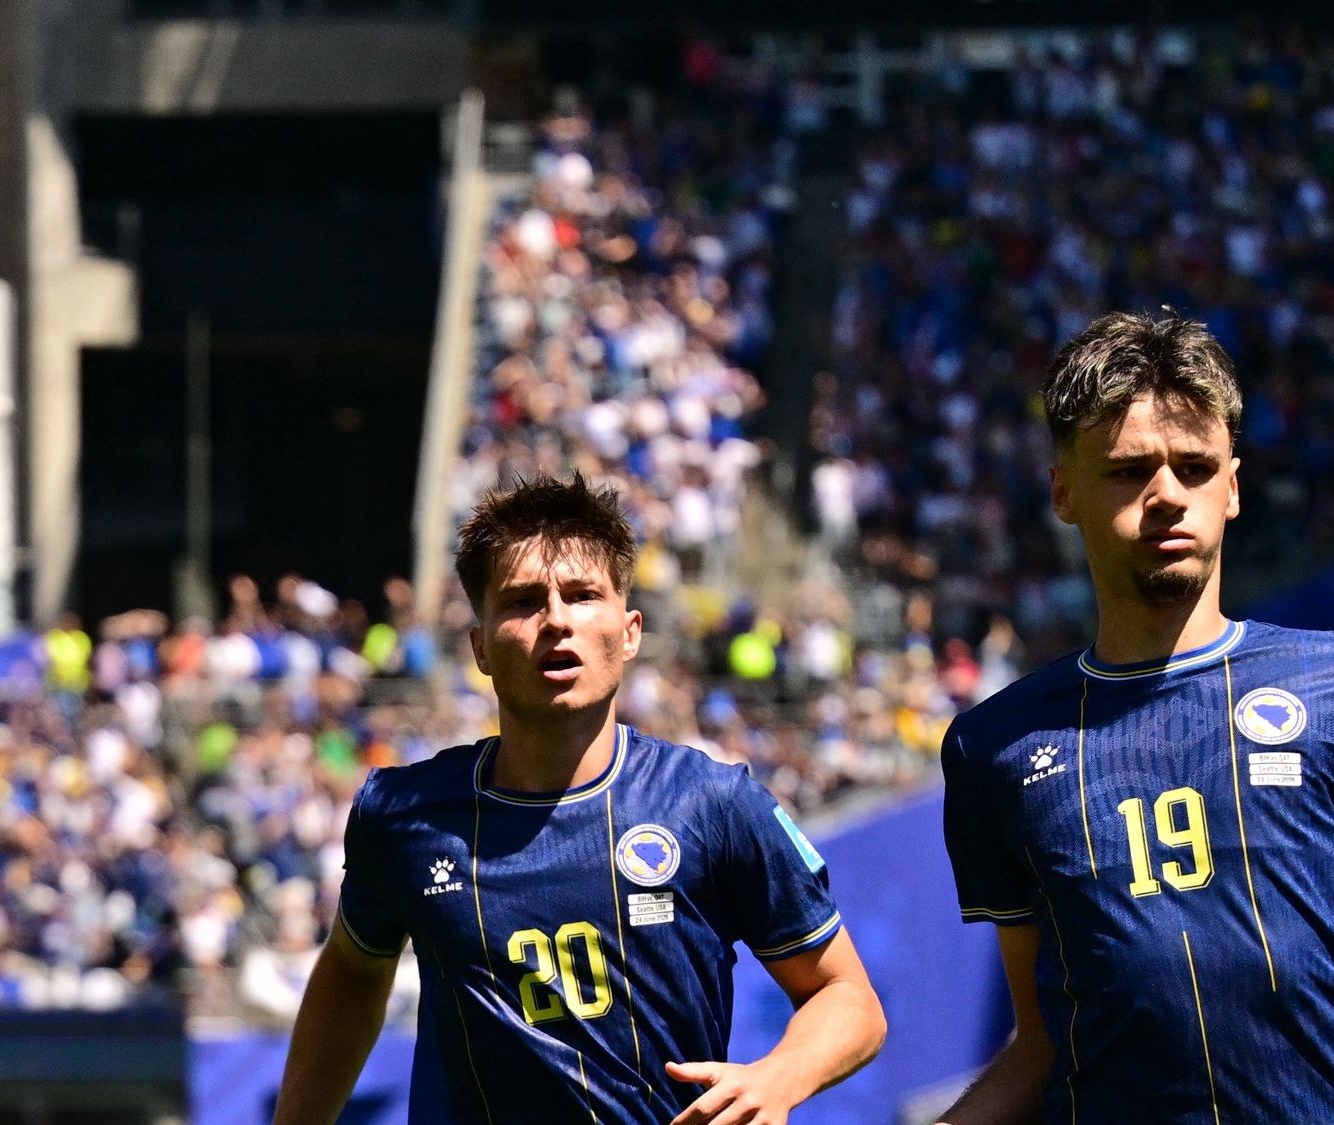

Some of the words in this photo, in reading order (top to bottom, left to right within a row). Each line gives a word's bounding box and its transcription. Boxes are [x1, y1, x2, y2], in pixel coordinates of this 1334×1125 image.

[1023, 763, 1067, 786] KELME
[1117, 786, 1216, 898] 19
[423, 881, 463, 897] KELME
[507, 919, 614, 1027] 20
